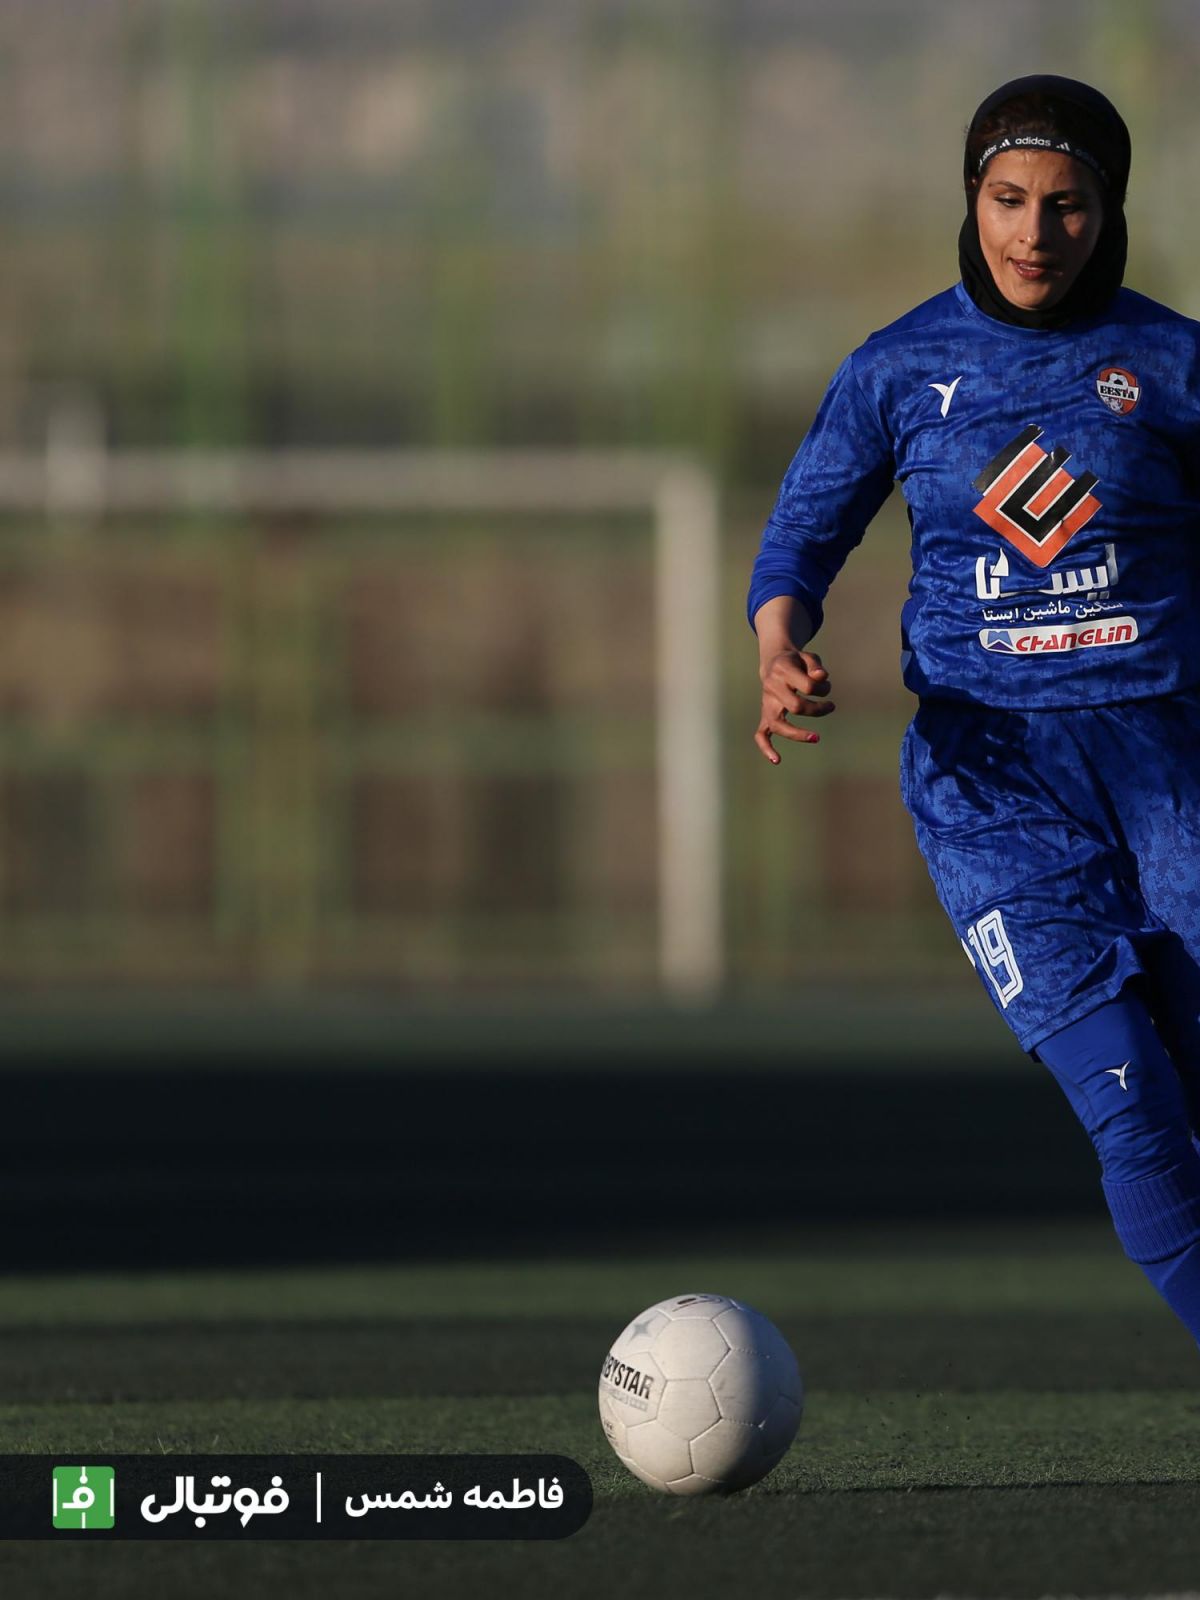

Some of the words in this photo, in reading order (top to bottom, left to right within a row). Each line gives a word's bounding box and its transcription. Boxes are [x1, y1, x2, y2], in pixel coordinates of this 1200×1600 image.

[1015, 136, 1051, 147] adidas
[1100, 385, 1135, 400] EESTA
[982, 607, 1019, 623] ایستا
[1023, 600, 1071, 621] ماشین
[967, 910, 1024, 1009] 19
